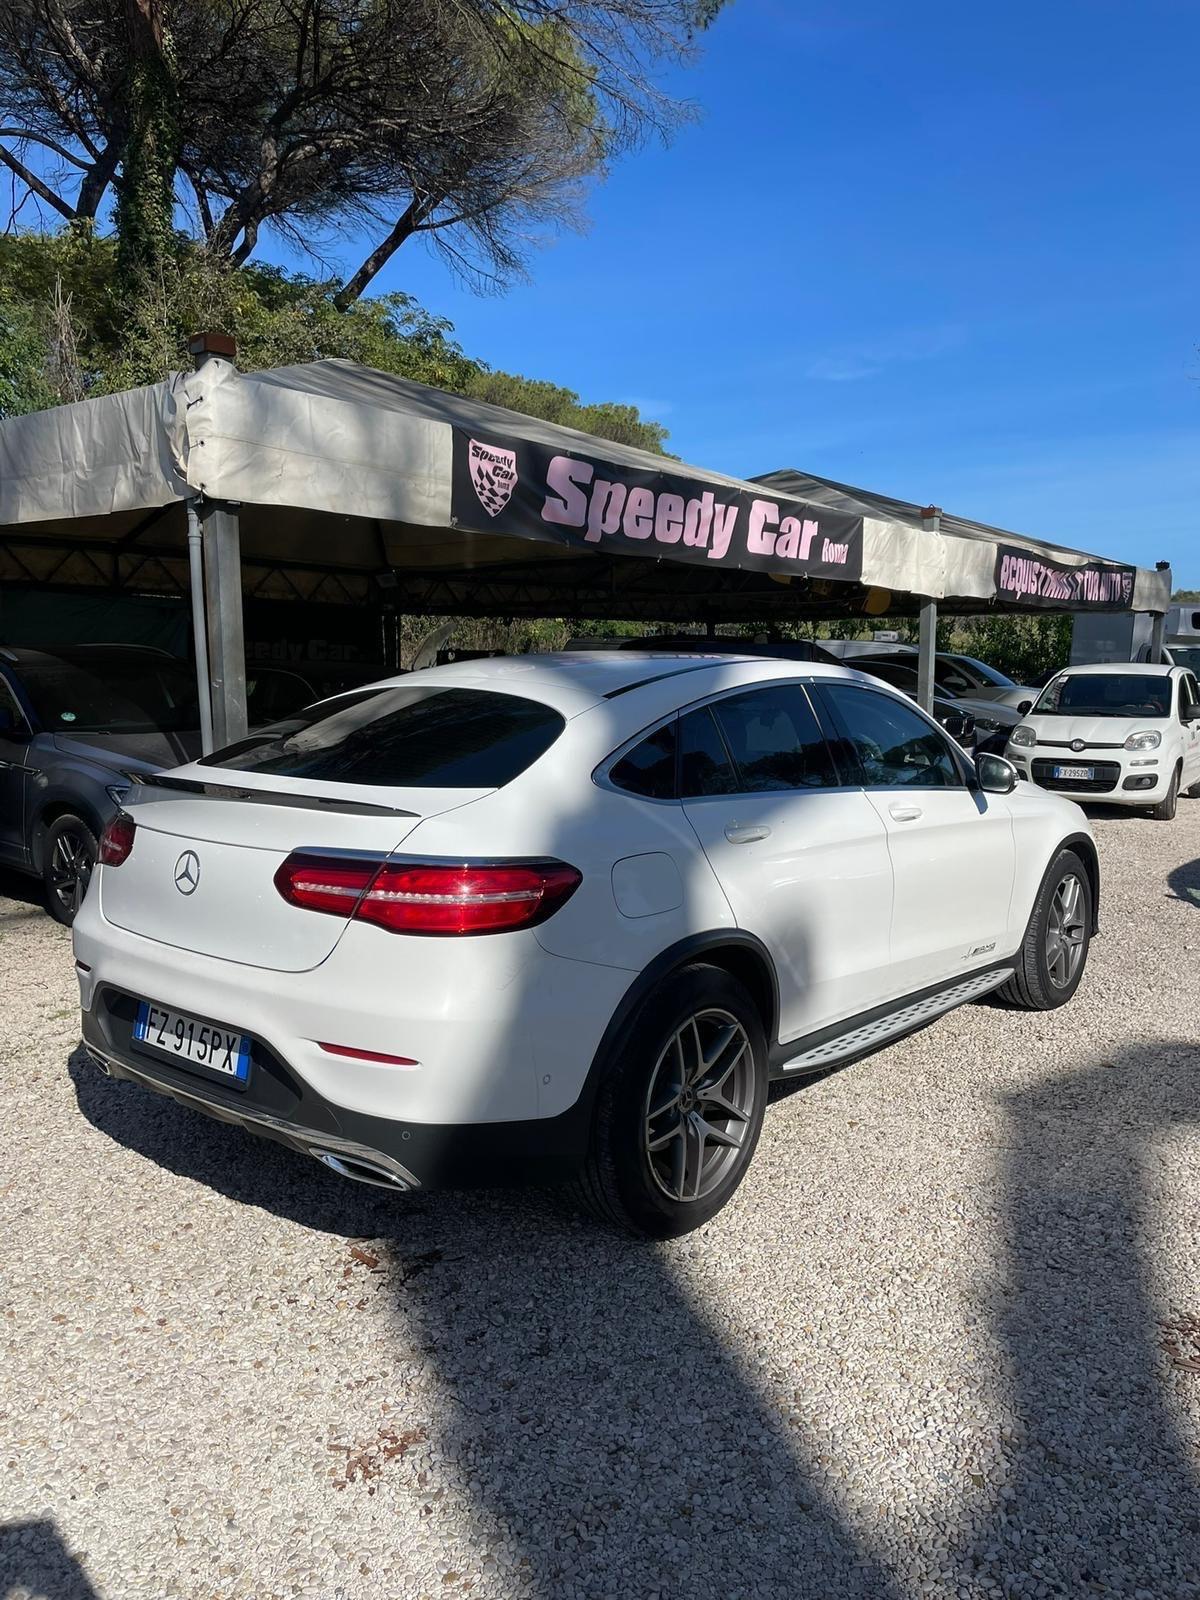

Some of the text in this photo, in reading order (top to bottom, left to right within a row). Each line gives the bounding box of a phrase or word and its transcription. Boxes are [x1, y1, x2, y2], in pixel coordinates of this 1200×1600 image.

[471, 445, 513, 469] Speedy
[491, 465, 515, 481] Car
[540, 455, 849, 565] Speedy Car Roma
[1083, 570, 1099, 601] TUA
[1099, 572, 1121, 602] AUTO
[147, 1007, 237, 1071] FZ 915PX
